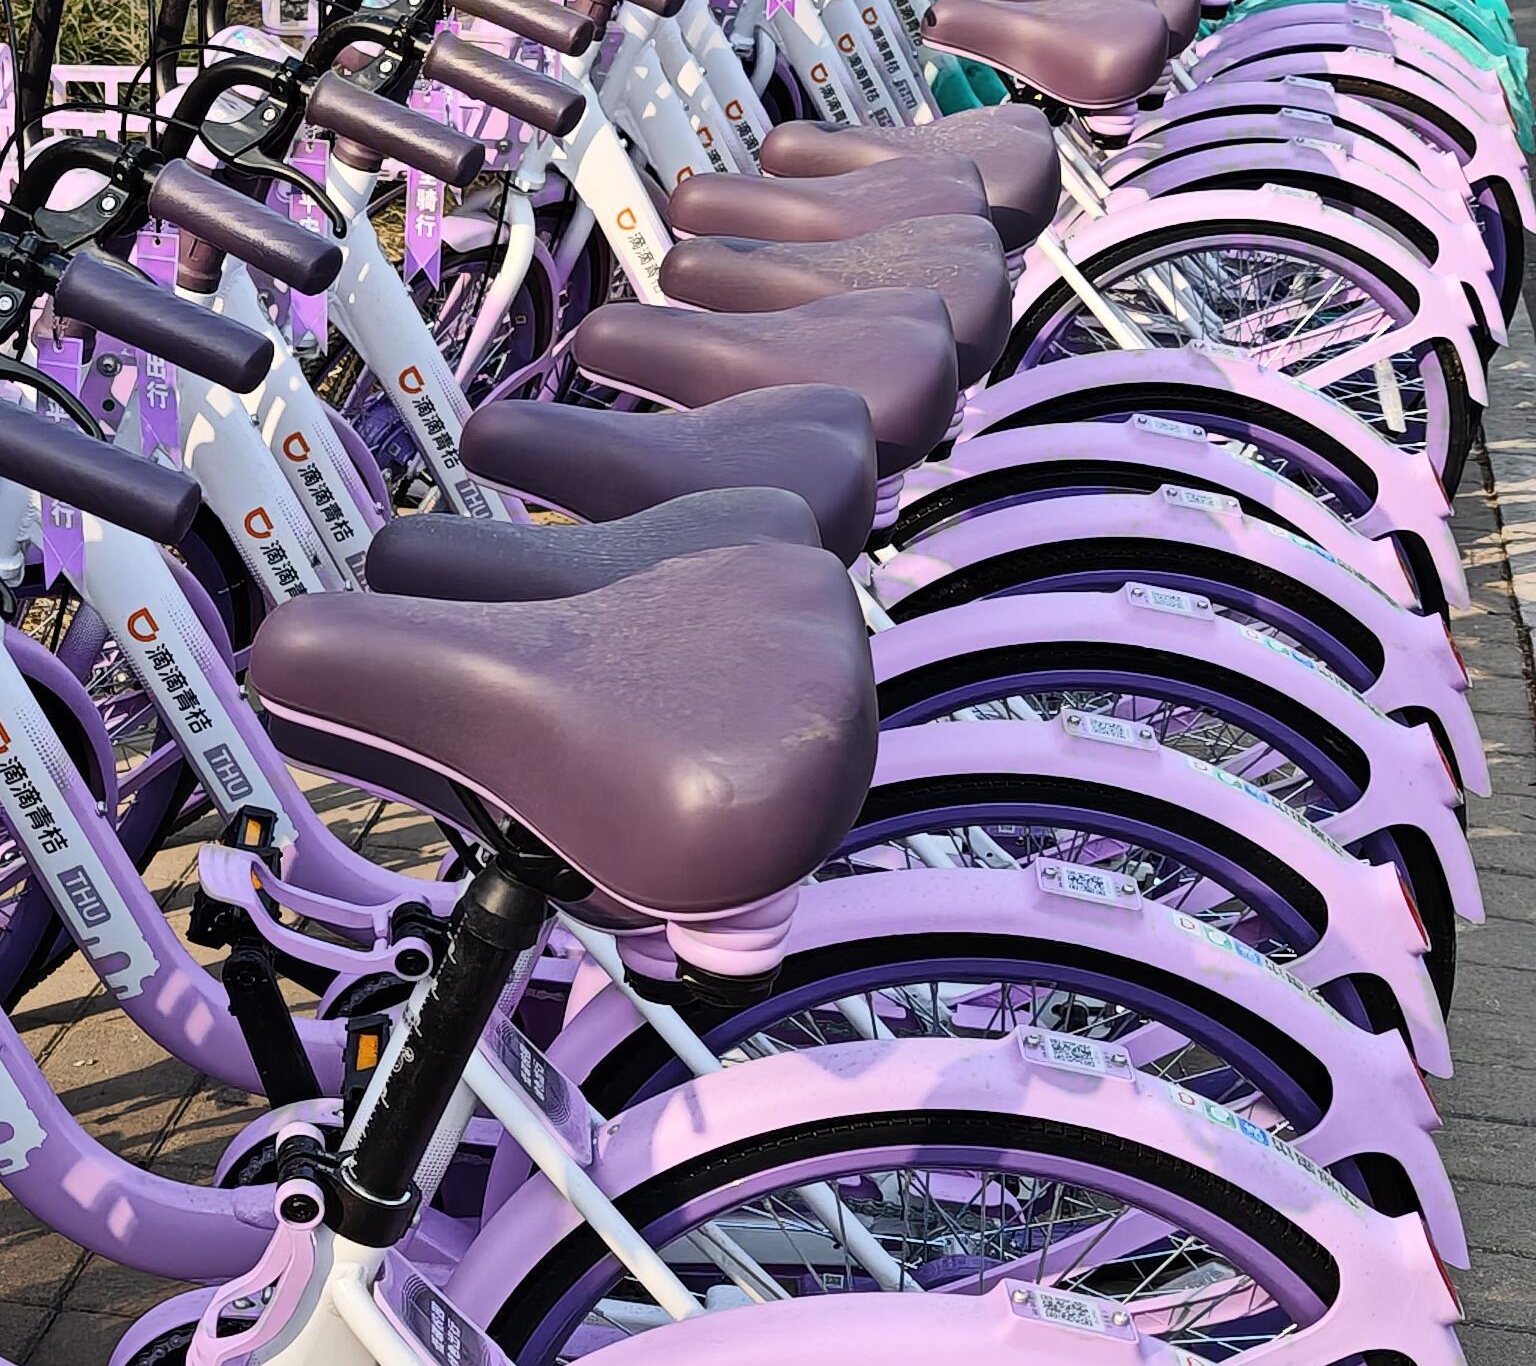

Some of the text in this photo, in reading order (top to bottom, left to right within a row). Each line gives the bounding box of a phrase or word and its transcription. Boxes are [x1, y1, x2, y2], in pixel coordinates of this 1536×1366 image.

[411, 394, 461, 469] 滴滴青桔
[297, 462, 355, 543] 滴滴青桔
[145, 642, 213, 734] 滴滴青桔
[208, 746, 251, 800] THU
[63, 868, 109, 926] THU
